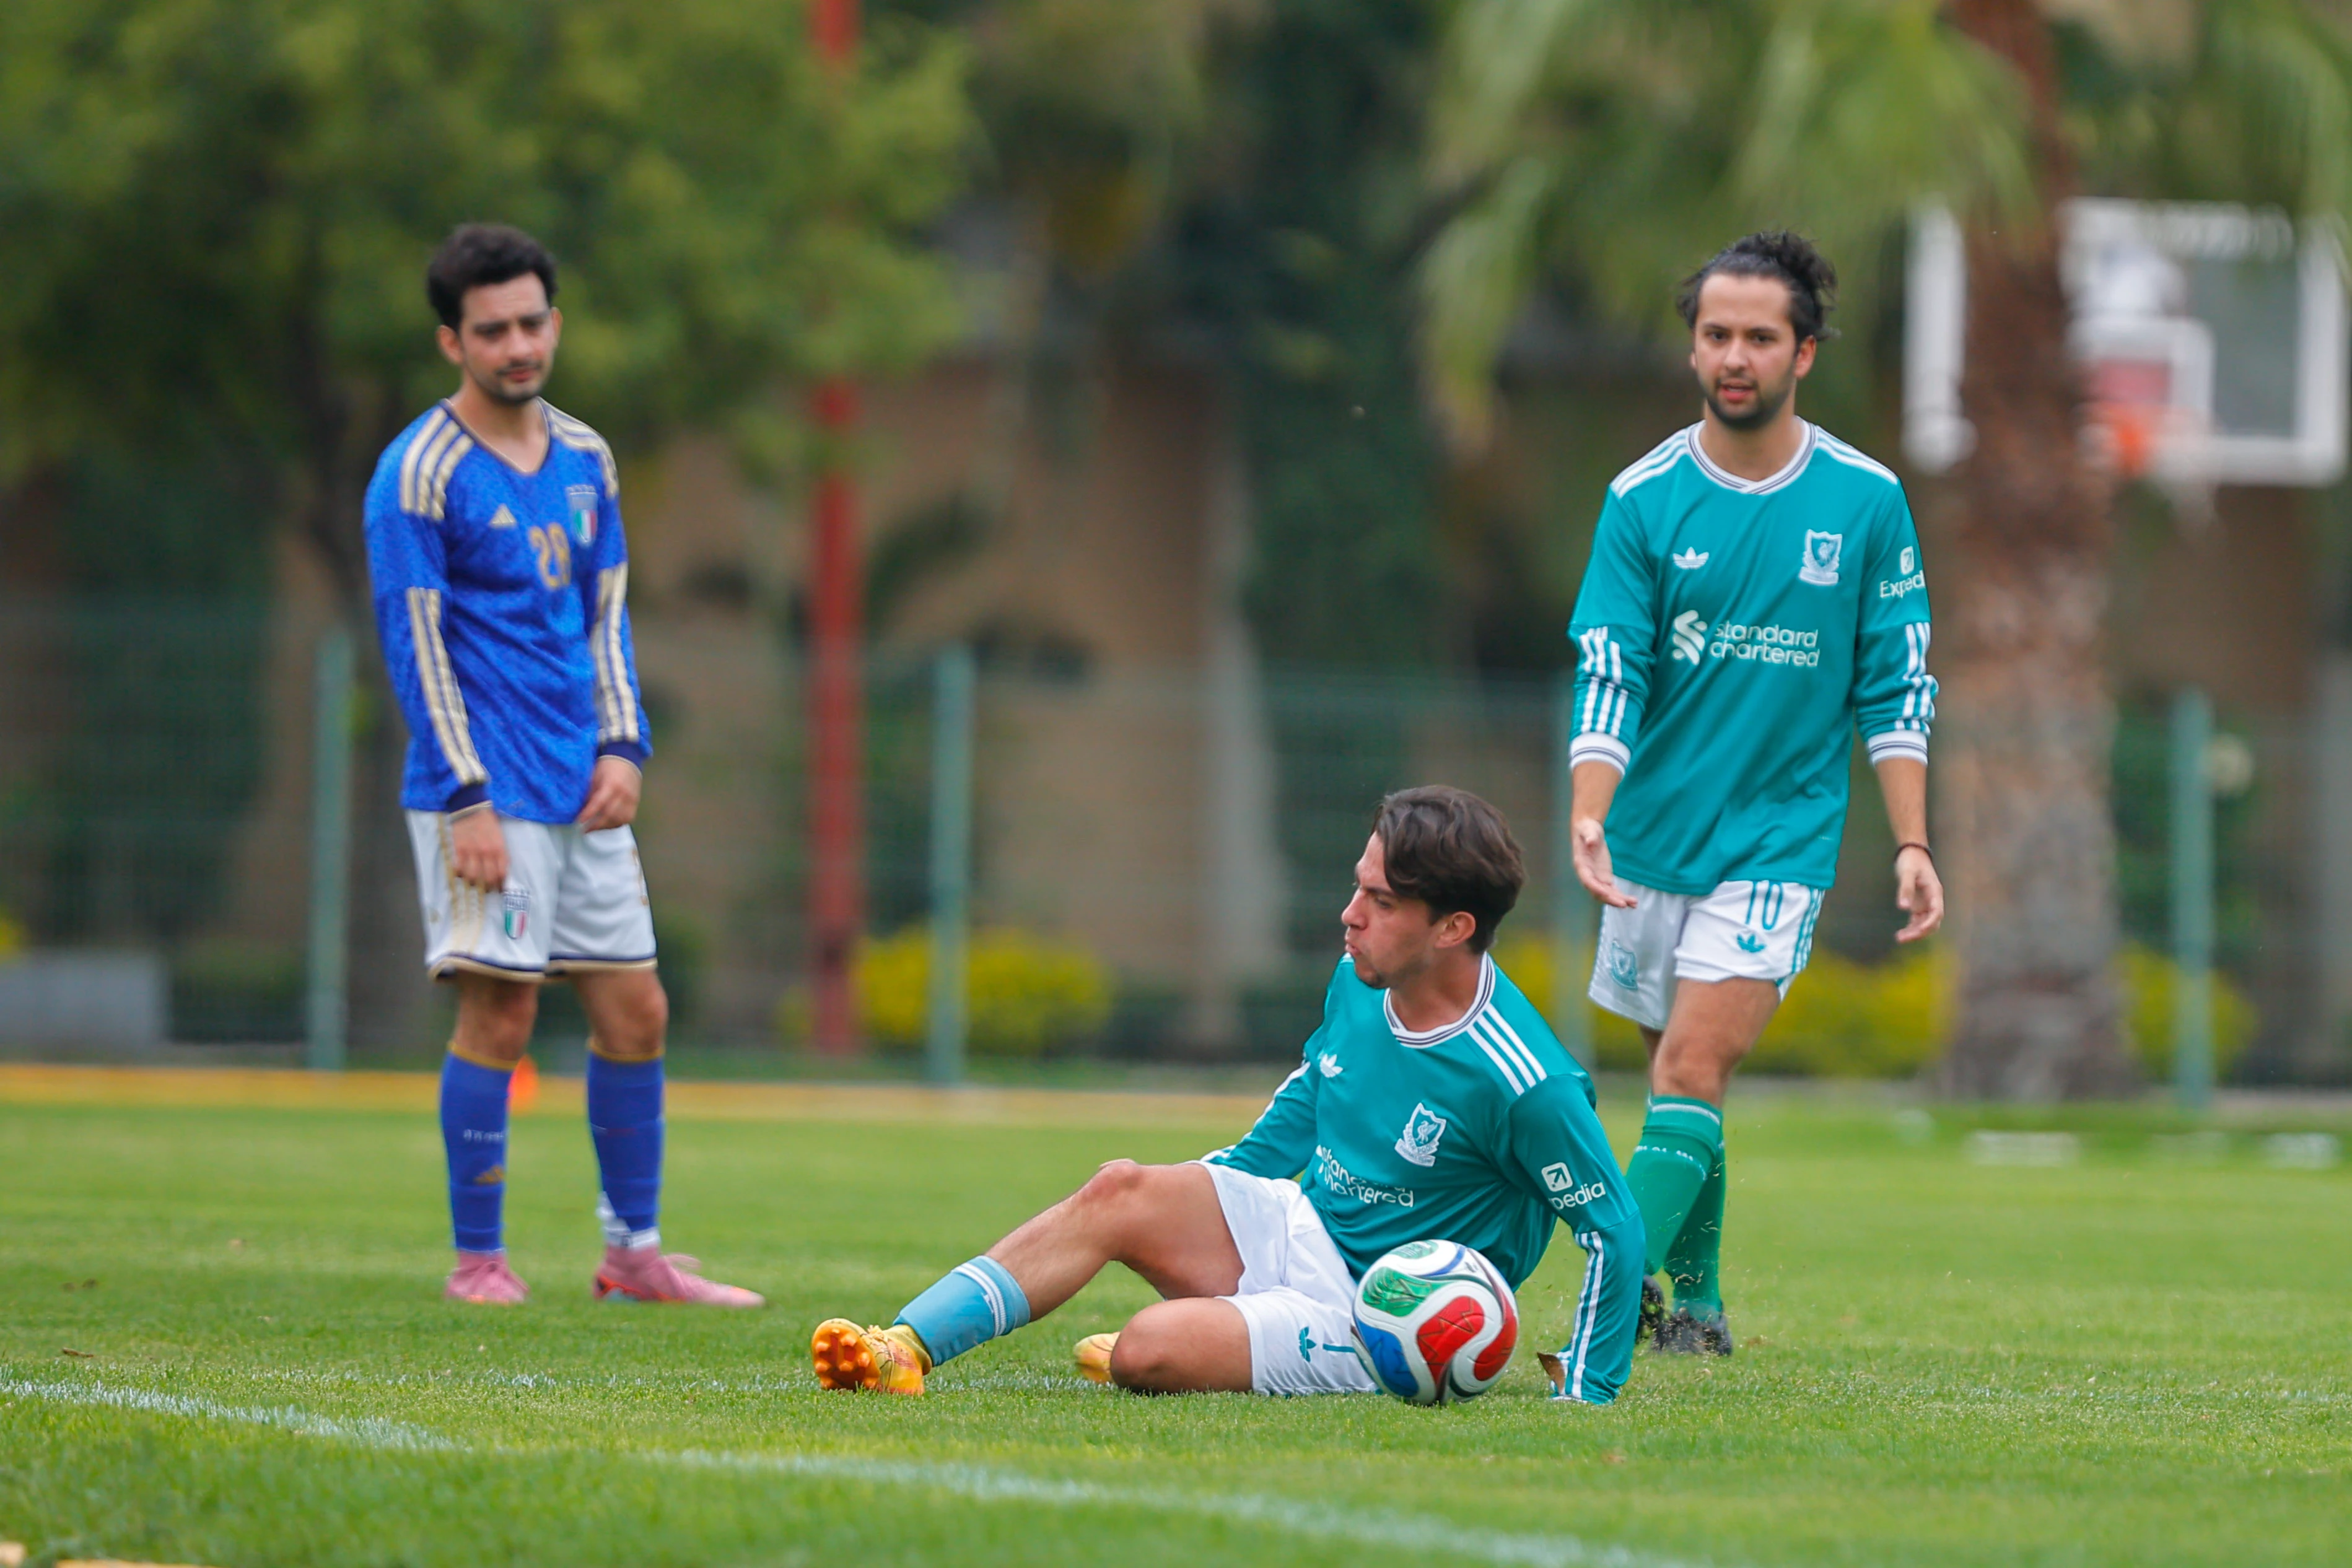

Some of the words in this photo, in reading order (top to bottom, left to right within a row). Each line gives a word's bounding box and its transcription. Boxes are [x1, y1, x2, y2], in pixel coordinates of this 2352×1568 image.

[1715, 620, 1819, 648] standard
[1710, 640, 1820, 667] chartered
[1746, 880, 1783, 930] 10
